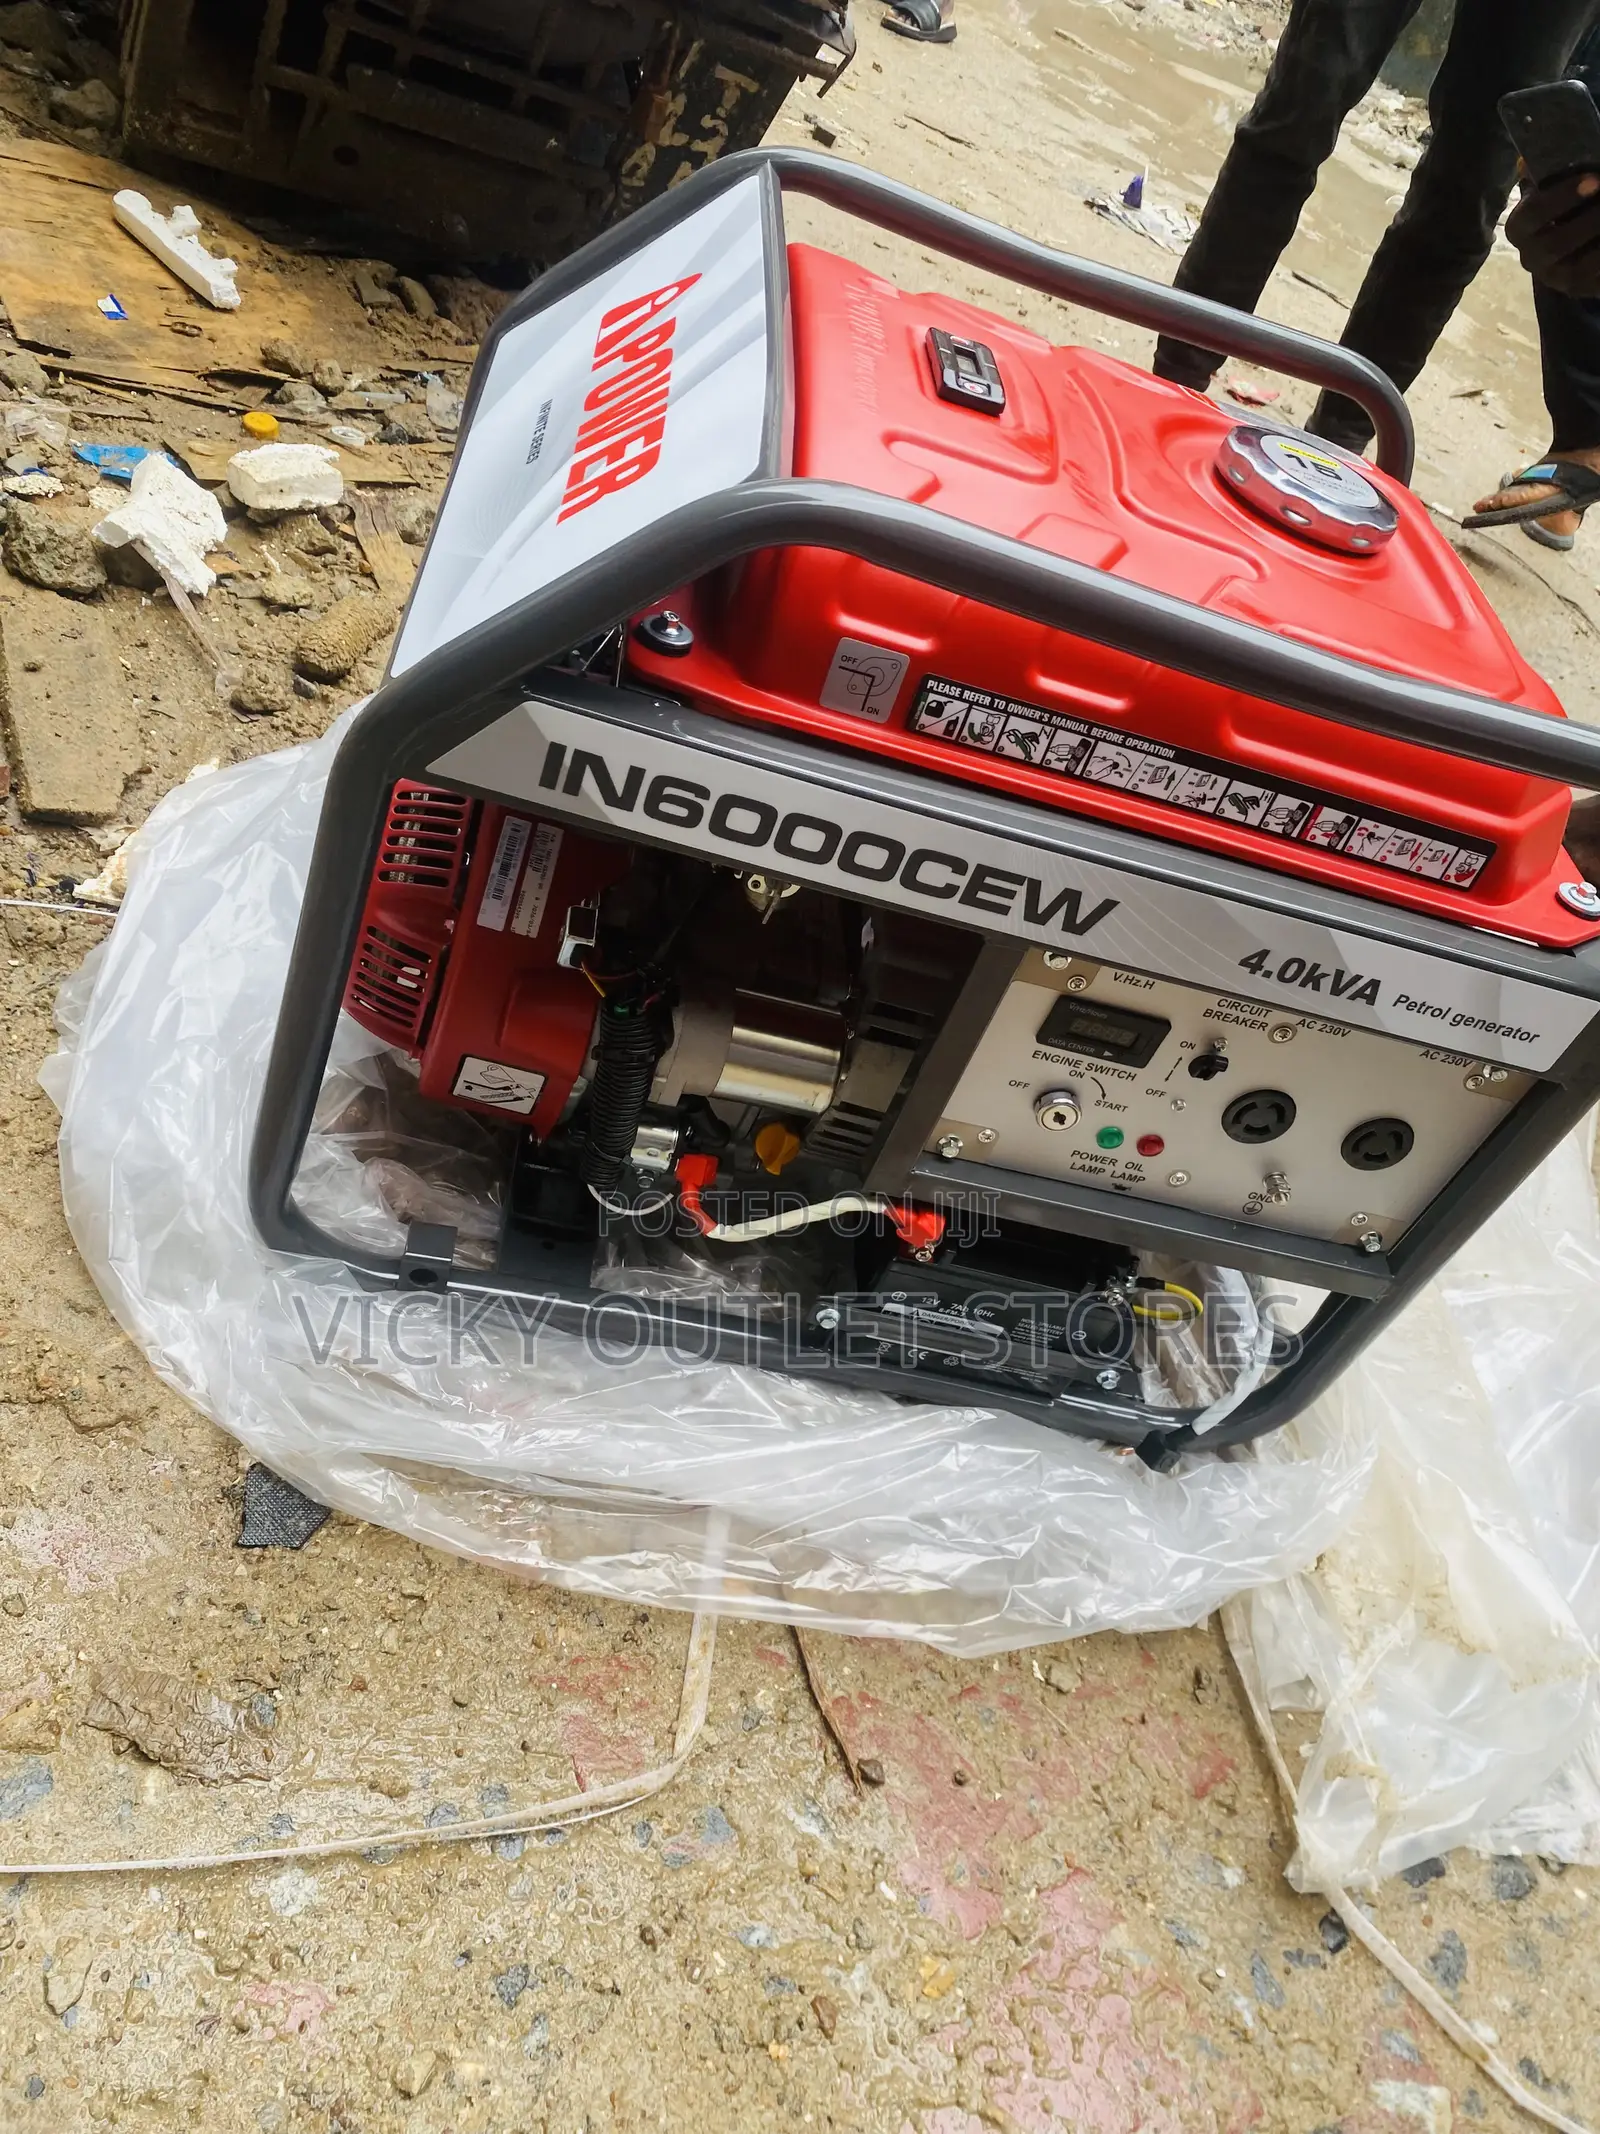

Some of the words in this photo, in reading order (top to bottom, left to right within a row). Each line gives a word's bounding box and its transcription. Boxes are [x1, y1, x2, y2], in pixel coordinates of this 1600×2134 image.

[1284, 453, 1343, 481] 15
[840, 654, 859, 665] OFF
[866, 706, 880, 716] ON
[926, 679, 962, 697] PLEASE
[962, 689, 993, 707] REFER
[993, 699, 1007, 710] TO
[1007, 702, 1050, 722] OWNER'S
[1050, 715, 1089, 734] MANUAL
[1090, 727, 1125, 745] BEFORE
[1125, 736, 1176, 759] OPERATION
[538, 741, 1121, 937] IN6000CEW
[1238, 948, 1382, 1007] 4.0kVA
[1392, 993, 1452, 1020] Petrol
[1449, 1012, 1541, 1044] generator
[1216, 998, 1273, 1019] CIRCUIT
[1202, 1008, 1269, 1033] BREAKER
[1295, 1018, 1318, 1031] AC
[1317, 1022, 1352, 1039] 230V
[1048, 1037, 1067, 1048] DATA
[1067, 1041, 1095, 1054] CENTER
[1179, 1040, 1197, 1051] ON
[1031, 1050, 1084, 1069] ENGINE
[1084, 1062, 1138, 1082] SWITCH
[1419, 1049, 1441, 1061] AC
[1440, 1053, 1474, 1069] 230V
[1008, 1079, 1031, 1090] OFF
[1068, 1069, 1086, 1079] ON
[1145, 1088, 1168, 1099] OFF
[1093, 1099, 1129, 1113] START
[1070, 1149, 1119, 1167] POWER
[1124, 1161, 1145, 1173] OIL
[1069, 1162, 1106, 1176] LAMP
[1110, 1170, 1146, 1184] LAMP
[921, 1296, 941, 1306] 12V
[972, 1307, 996, 1318] 10Hr
